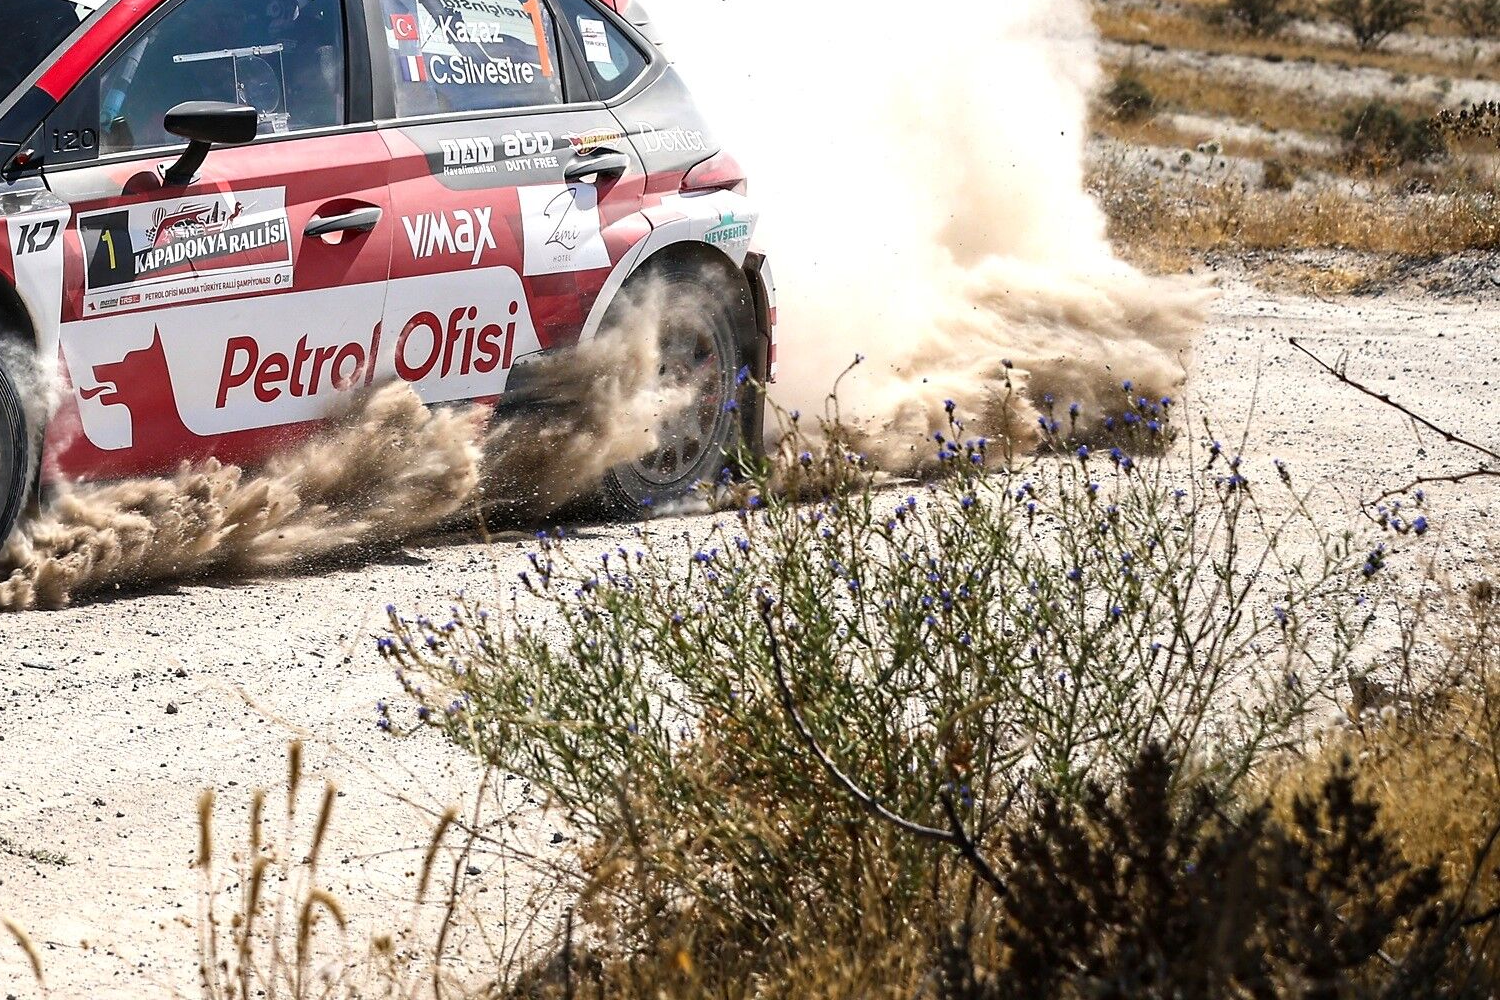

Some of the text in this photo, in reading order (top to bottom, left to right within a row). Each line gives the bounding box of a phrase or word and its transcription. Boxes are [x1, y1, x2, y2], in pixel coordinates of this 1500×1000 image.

[429, 54, 535, 85] C.Silvestre
[53, 128, 97, 153] i20
[441, 138, 494, 165] TAV
[505, 156, 560, 172] DUTY FREE
[101, 229, 117, 270] 1
[134, 233, 228, 274] KAPADOKYA
[145, 291, 164, 300] PETROL
[215, 301, 518, 409] Petrol Ofisi
